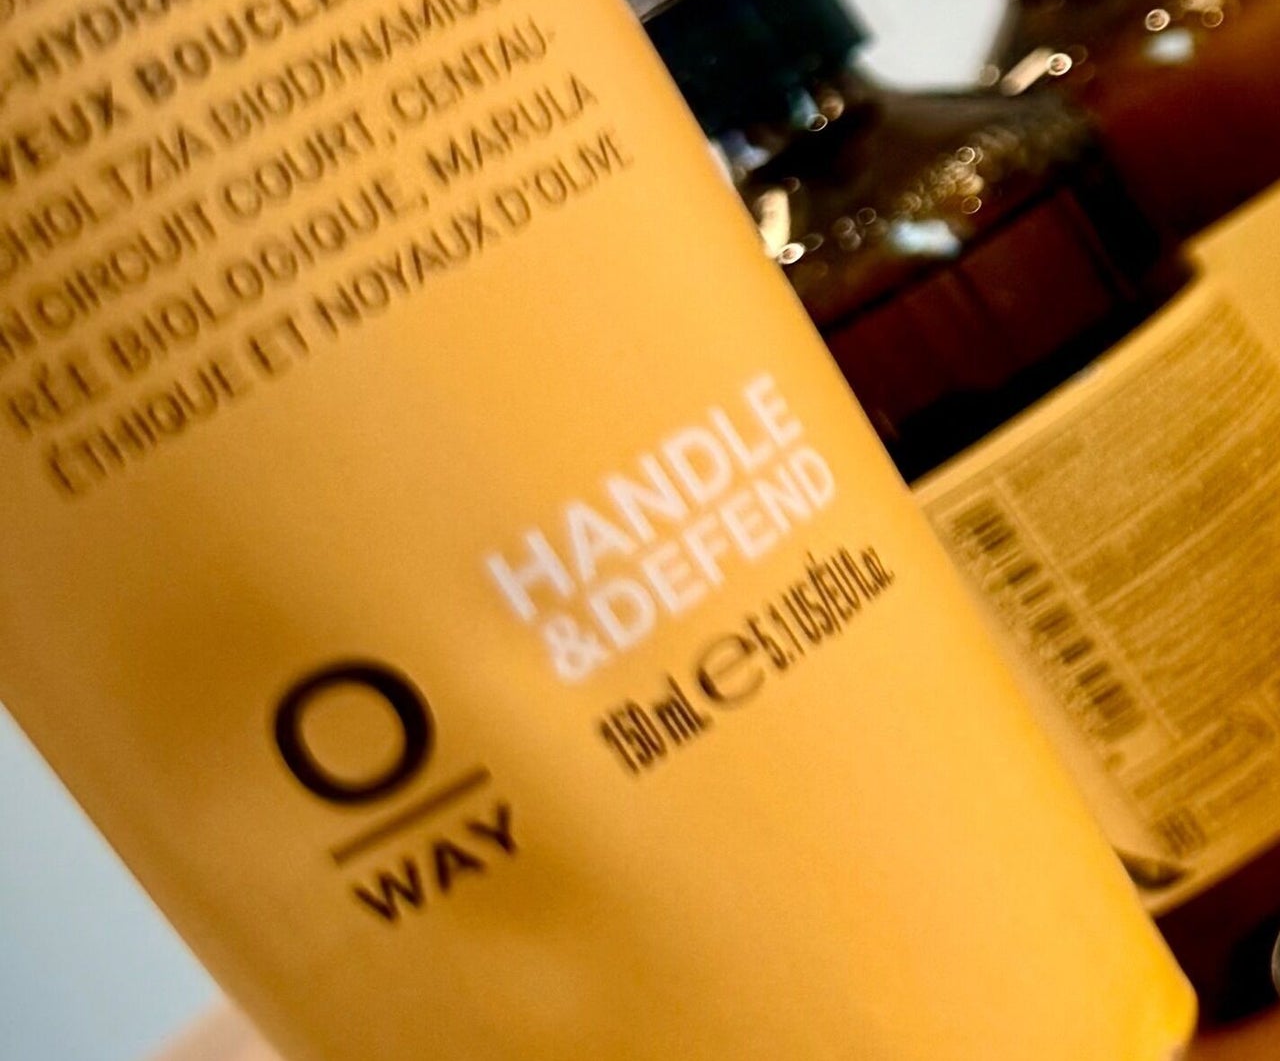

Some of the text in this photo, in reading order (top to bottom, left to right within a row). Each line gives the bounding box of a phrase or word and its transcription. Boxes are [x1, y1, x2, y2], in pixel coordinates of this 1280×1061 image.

[424, 71, 599, 186] MARULA
[30, 199, 217, 338] CIRCUIT
[43, 126, 633, 498] ÉTHIQUE ET NOYAUX D'OLIVE
[486, 372, 802, 622] HANDLE
[272, 655, 436, 808] O
[597, 698, 668, 775] 150
[350, 802, 520, 926] WAY
